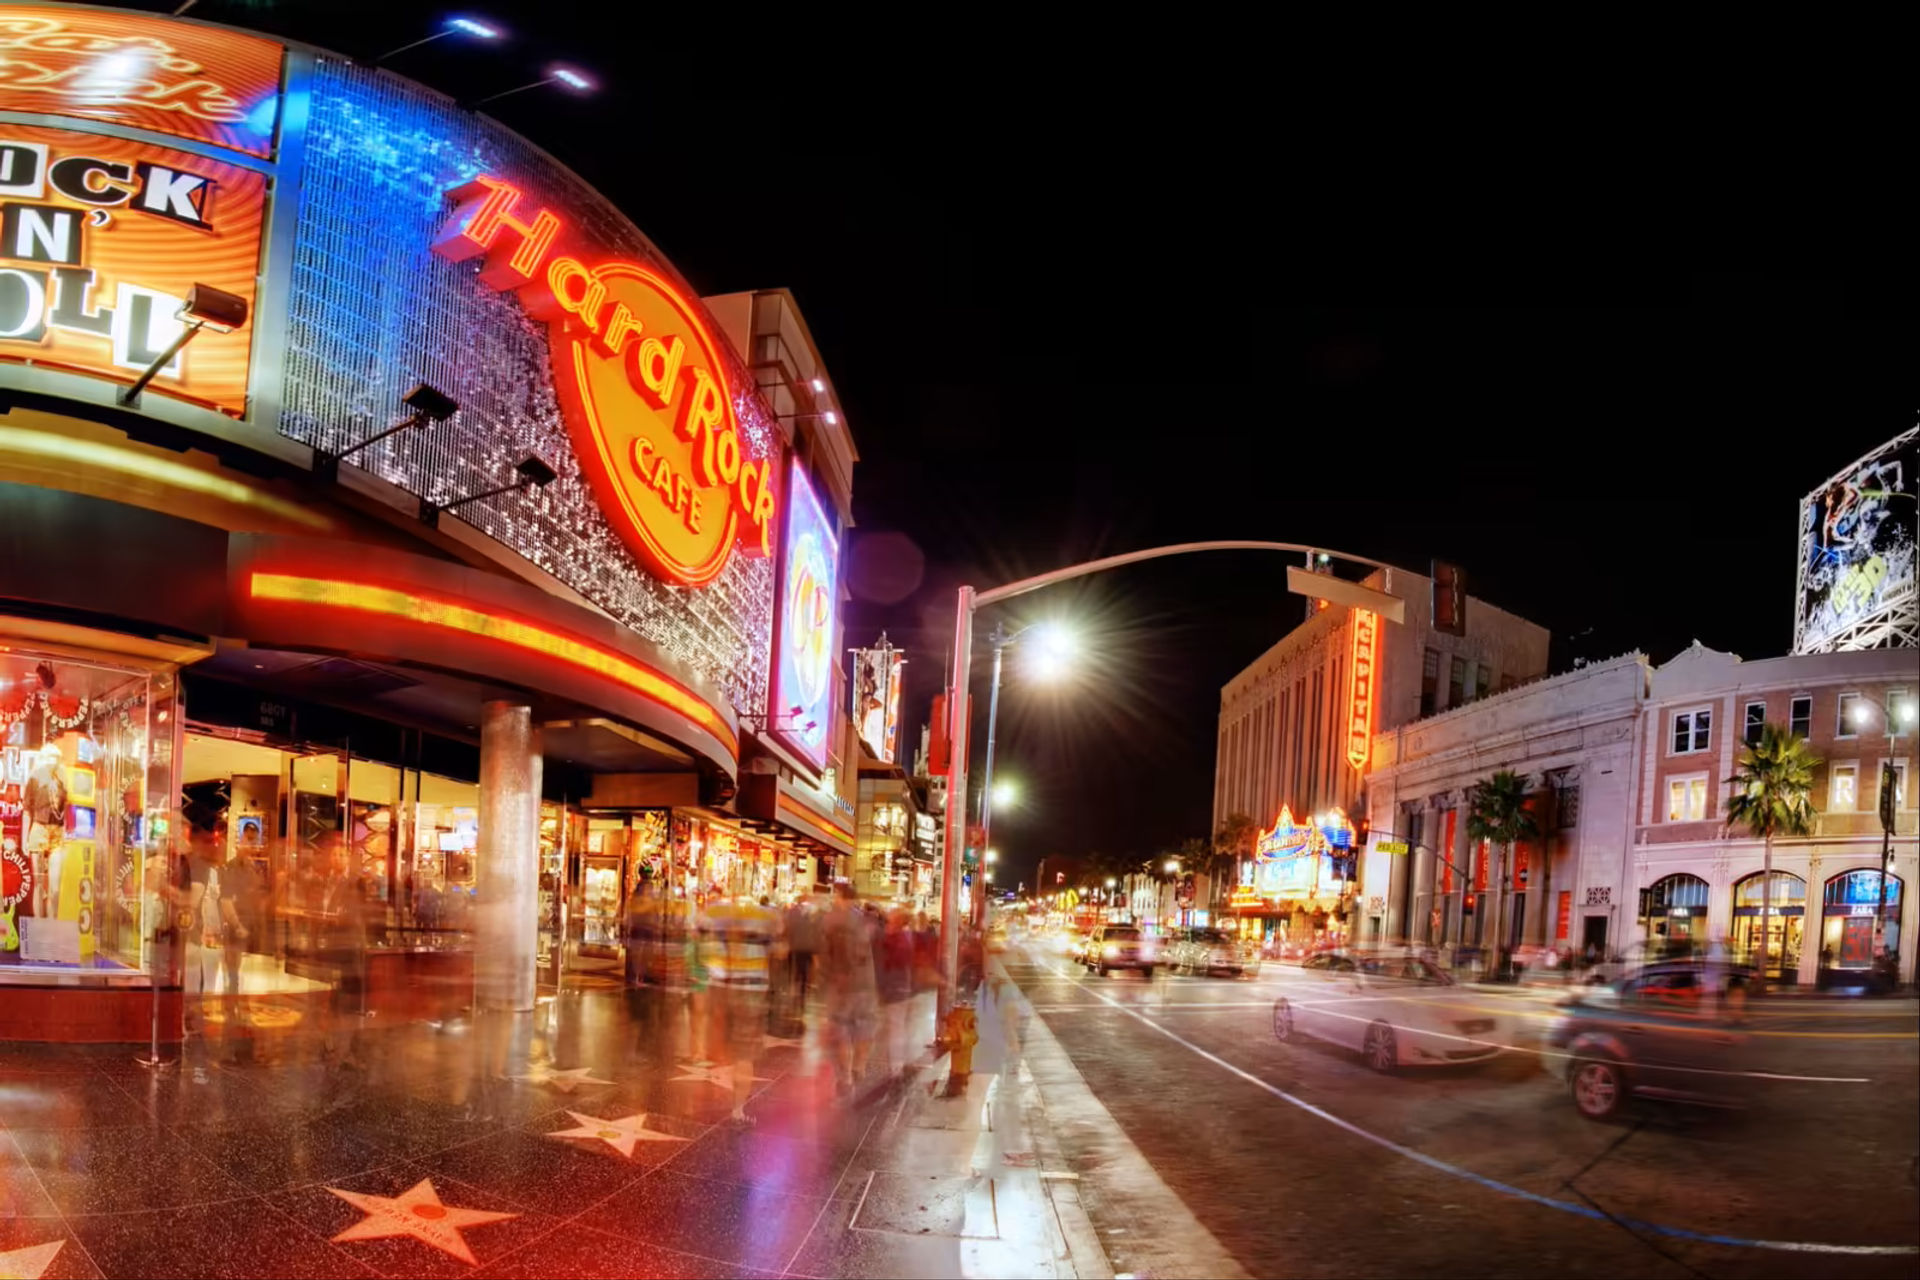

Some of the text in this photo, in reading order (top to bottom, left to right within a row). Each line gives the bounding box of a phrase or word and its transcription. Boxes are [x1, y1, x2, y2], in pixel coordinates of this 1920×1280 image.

[462, 173, 775, 559] Hard Rock
[633, 436, 703, 533] CAFE
[3, 850, 30, 874] CHILI
